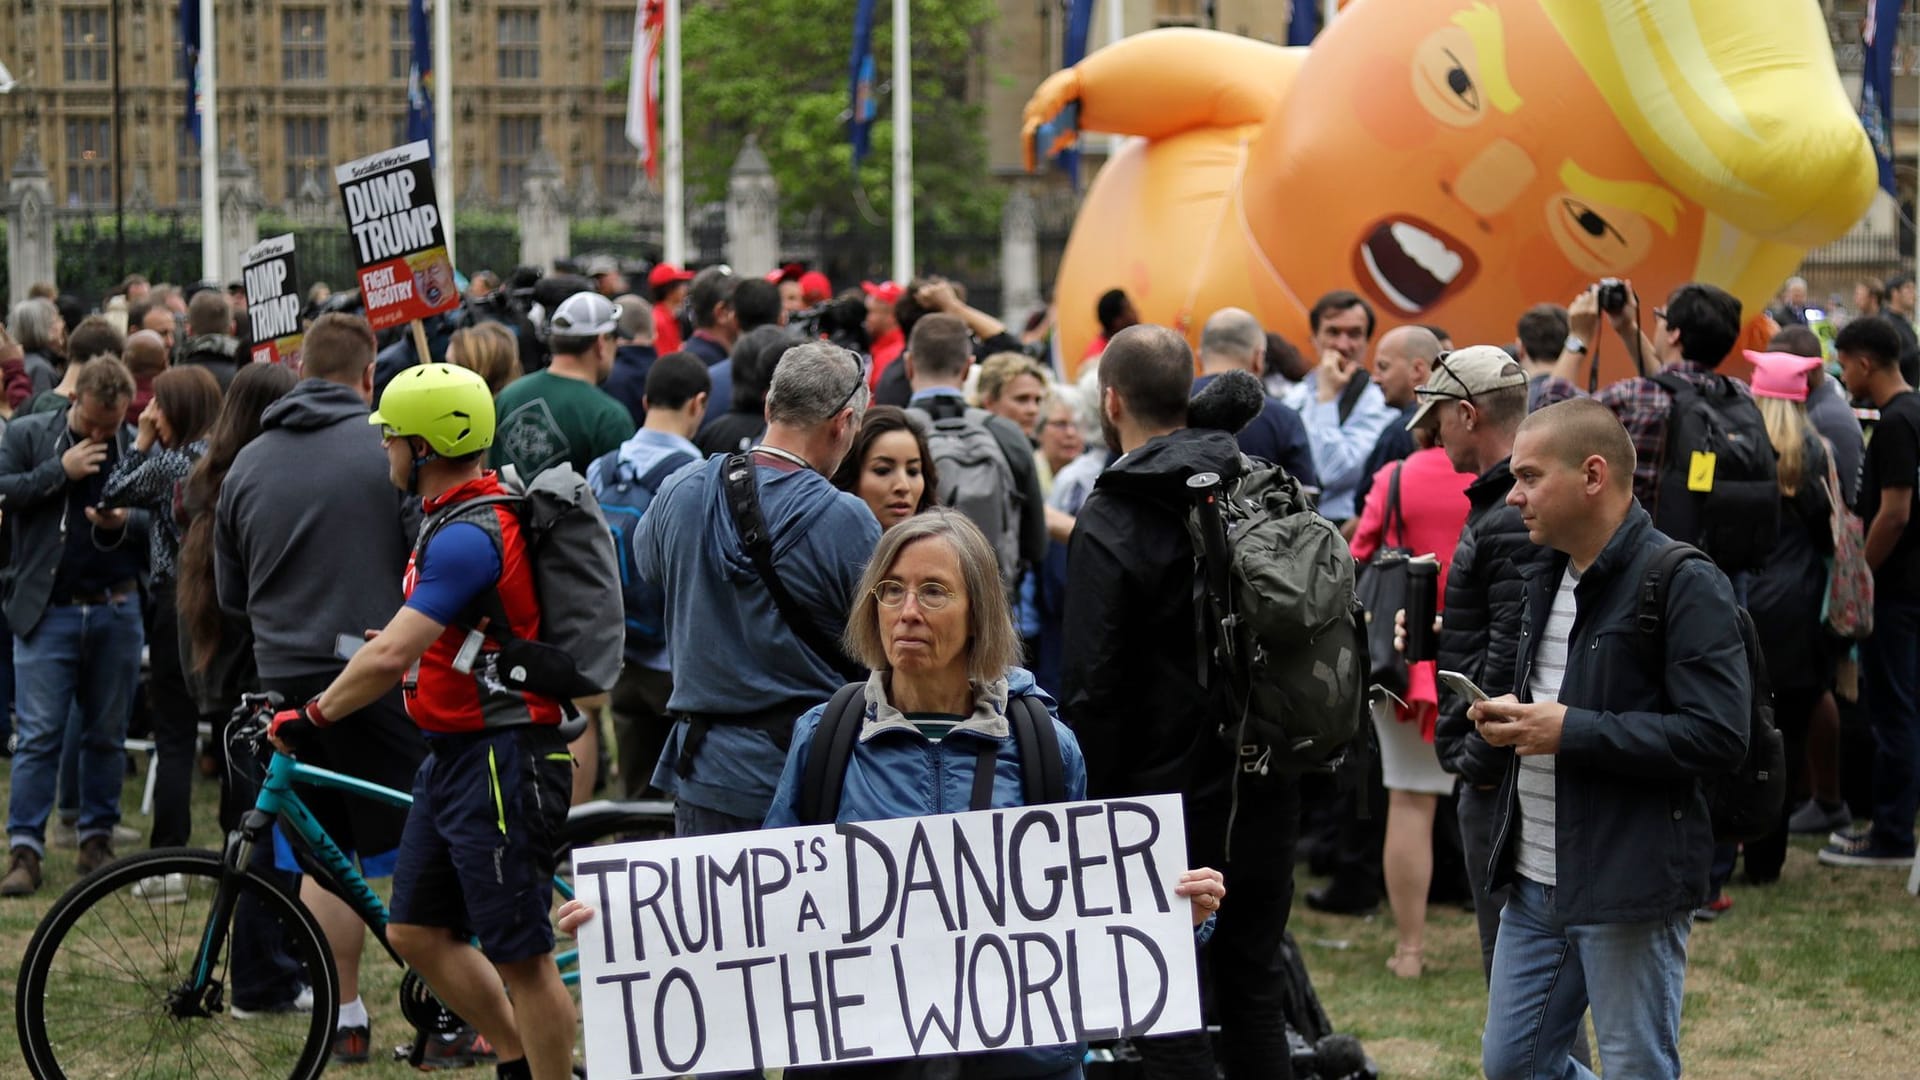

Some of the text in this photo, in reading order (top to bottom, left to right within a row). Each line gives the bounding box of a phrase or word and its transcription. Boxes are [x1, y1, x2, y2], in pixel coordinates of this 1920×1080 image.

[384, 153, 411, 168] Worker
[344, 168, 416, 225] DUMP
[352, 204, 438, 264] TRUMP
[245, 258, 287, 306] DUMP
[362, 266, 395, 292] FIGHT
[366, 279, 413, 310] BIGOTRY
[248, 293, 300, 343] TRUMP
[794, 836, 828, 874] IS
[835, 801, 1171, 944] DANGER
[577, 848, 792, 963] TRUMP
[797, 890, 826, 932] A
[596, 925, 1169, 1074] TO THE WORLD
